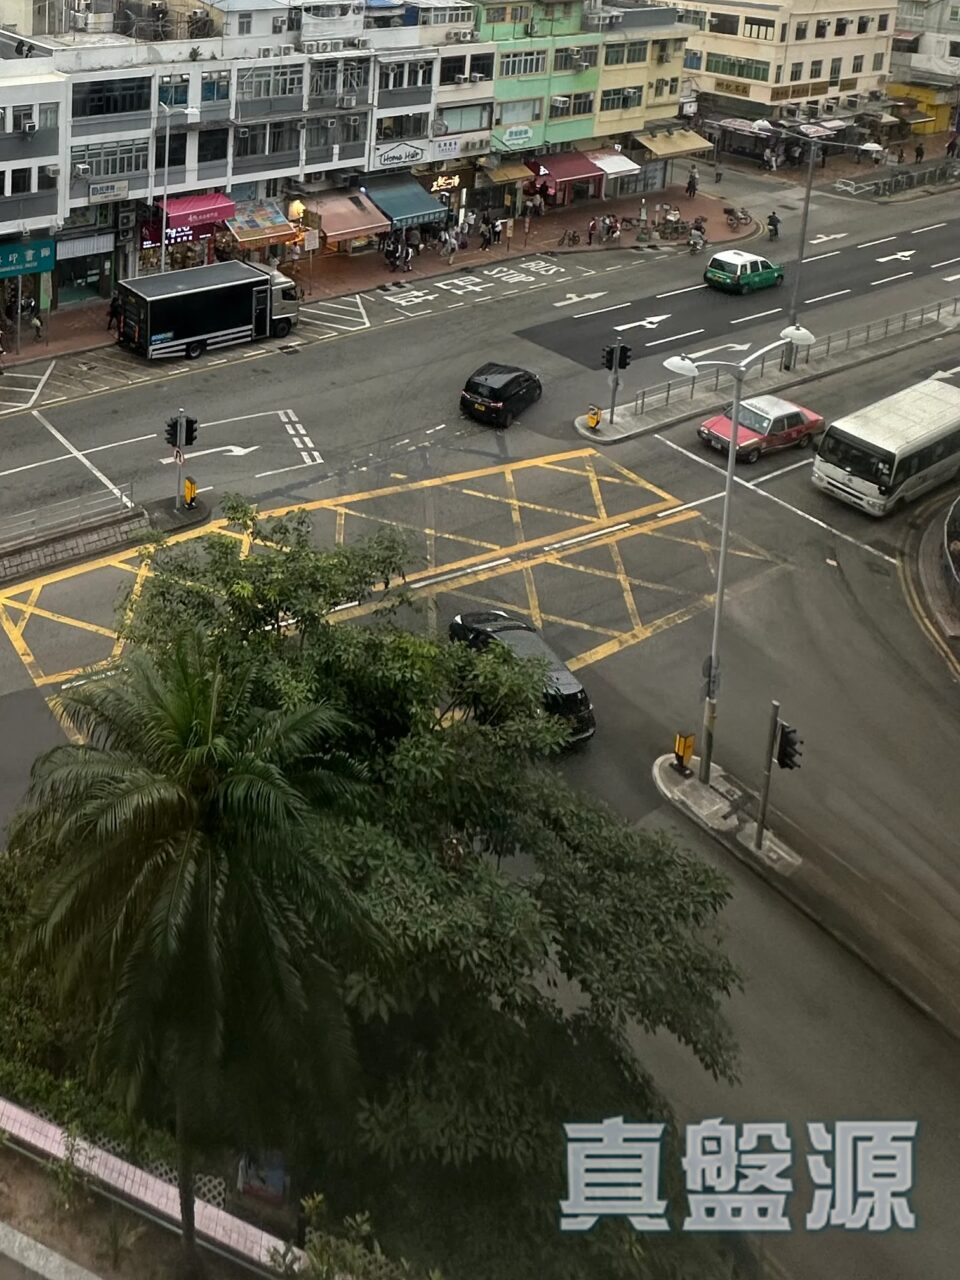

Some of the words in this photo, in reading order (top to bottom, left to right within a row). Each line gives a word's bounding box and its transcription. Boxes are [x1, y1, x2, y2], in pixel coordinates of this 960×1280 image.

[383, 153, 403, 163] Home
[404, 149, 420, 160] Hair
[483, 266, 536, 283] STOP
[519, 260, 565, 275] BUS
[434, 275, 495, 295] 巴士
[383, 289, 439, 307] 站
